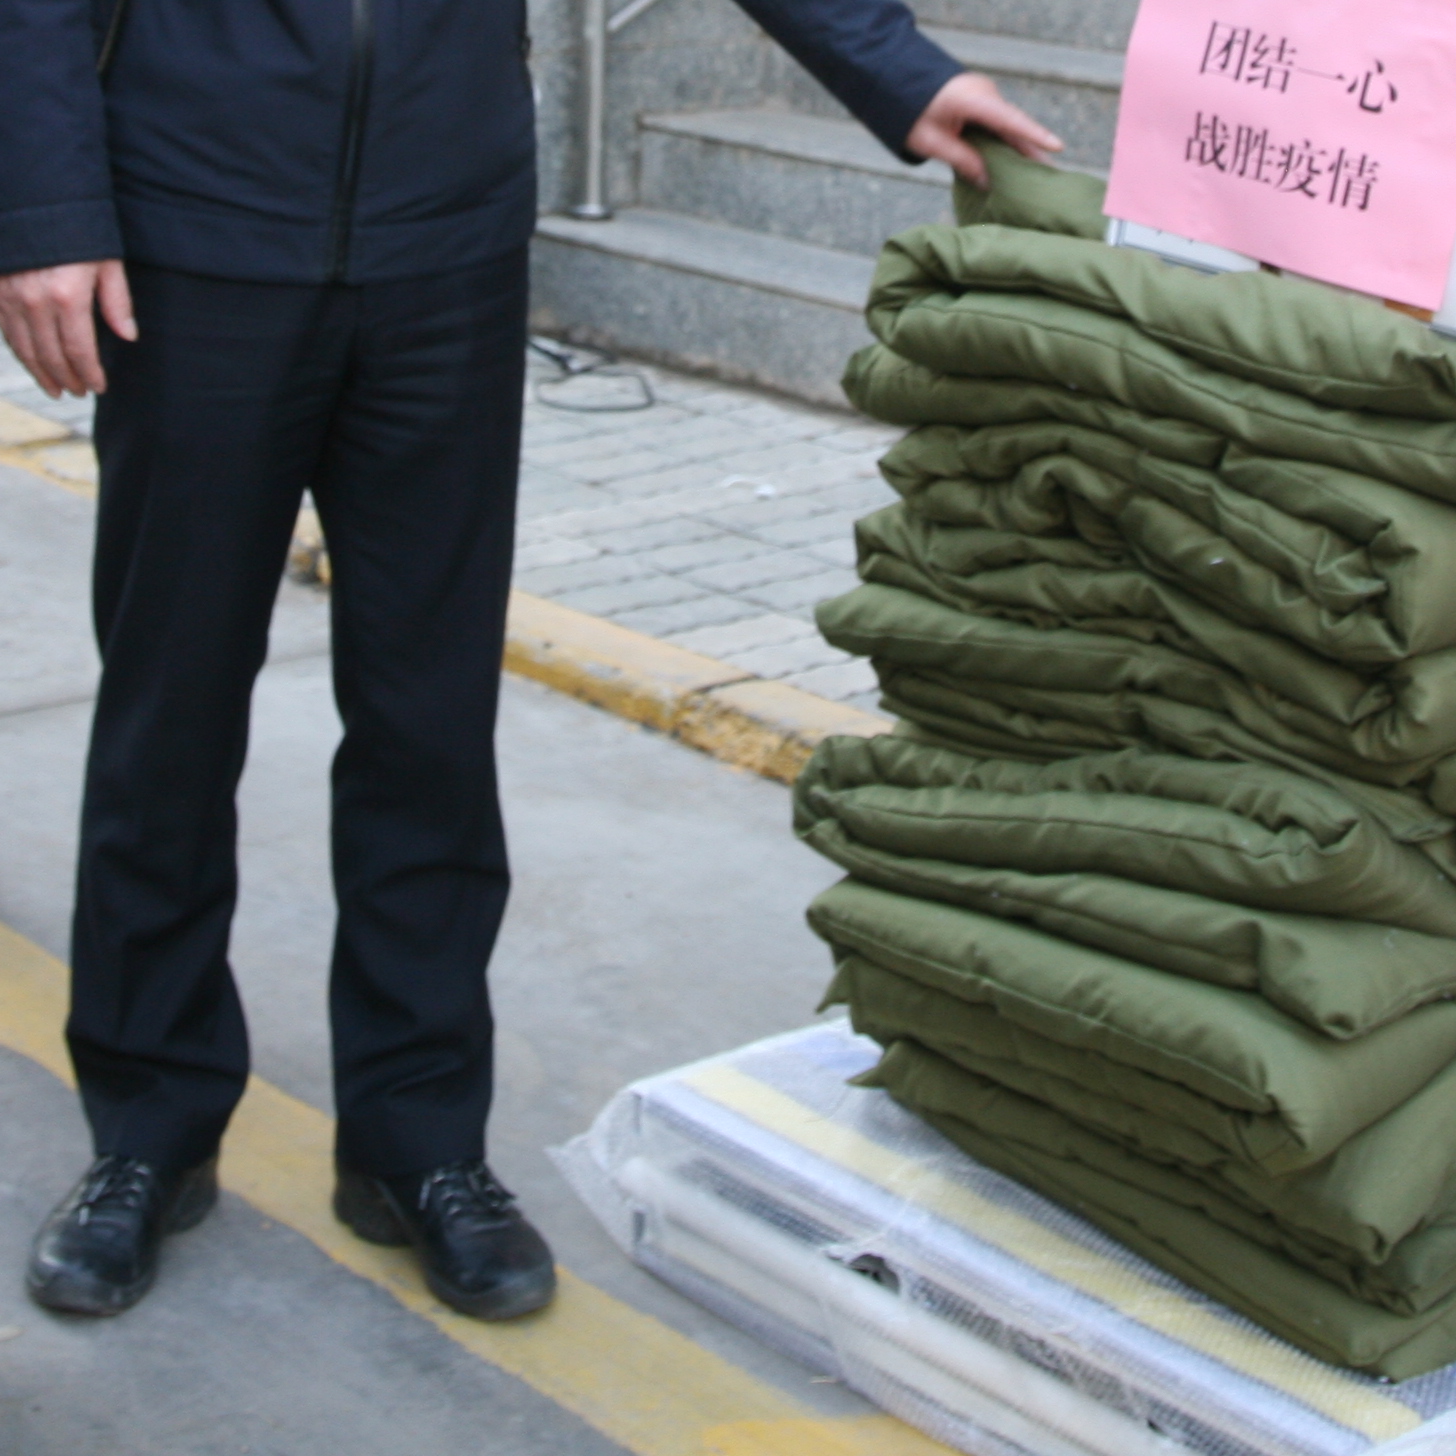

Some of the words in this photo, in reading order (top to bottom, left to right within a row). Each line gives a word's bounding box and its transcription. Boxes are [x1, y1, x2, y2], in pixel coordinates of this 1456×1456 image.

[1199, 21, 1398, 114] 团结一心
[1184, 111, 1381, 212] 战胜疫情
